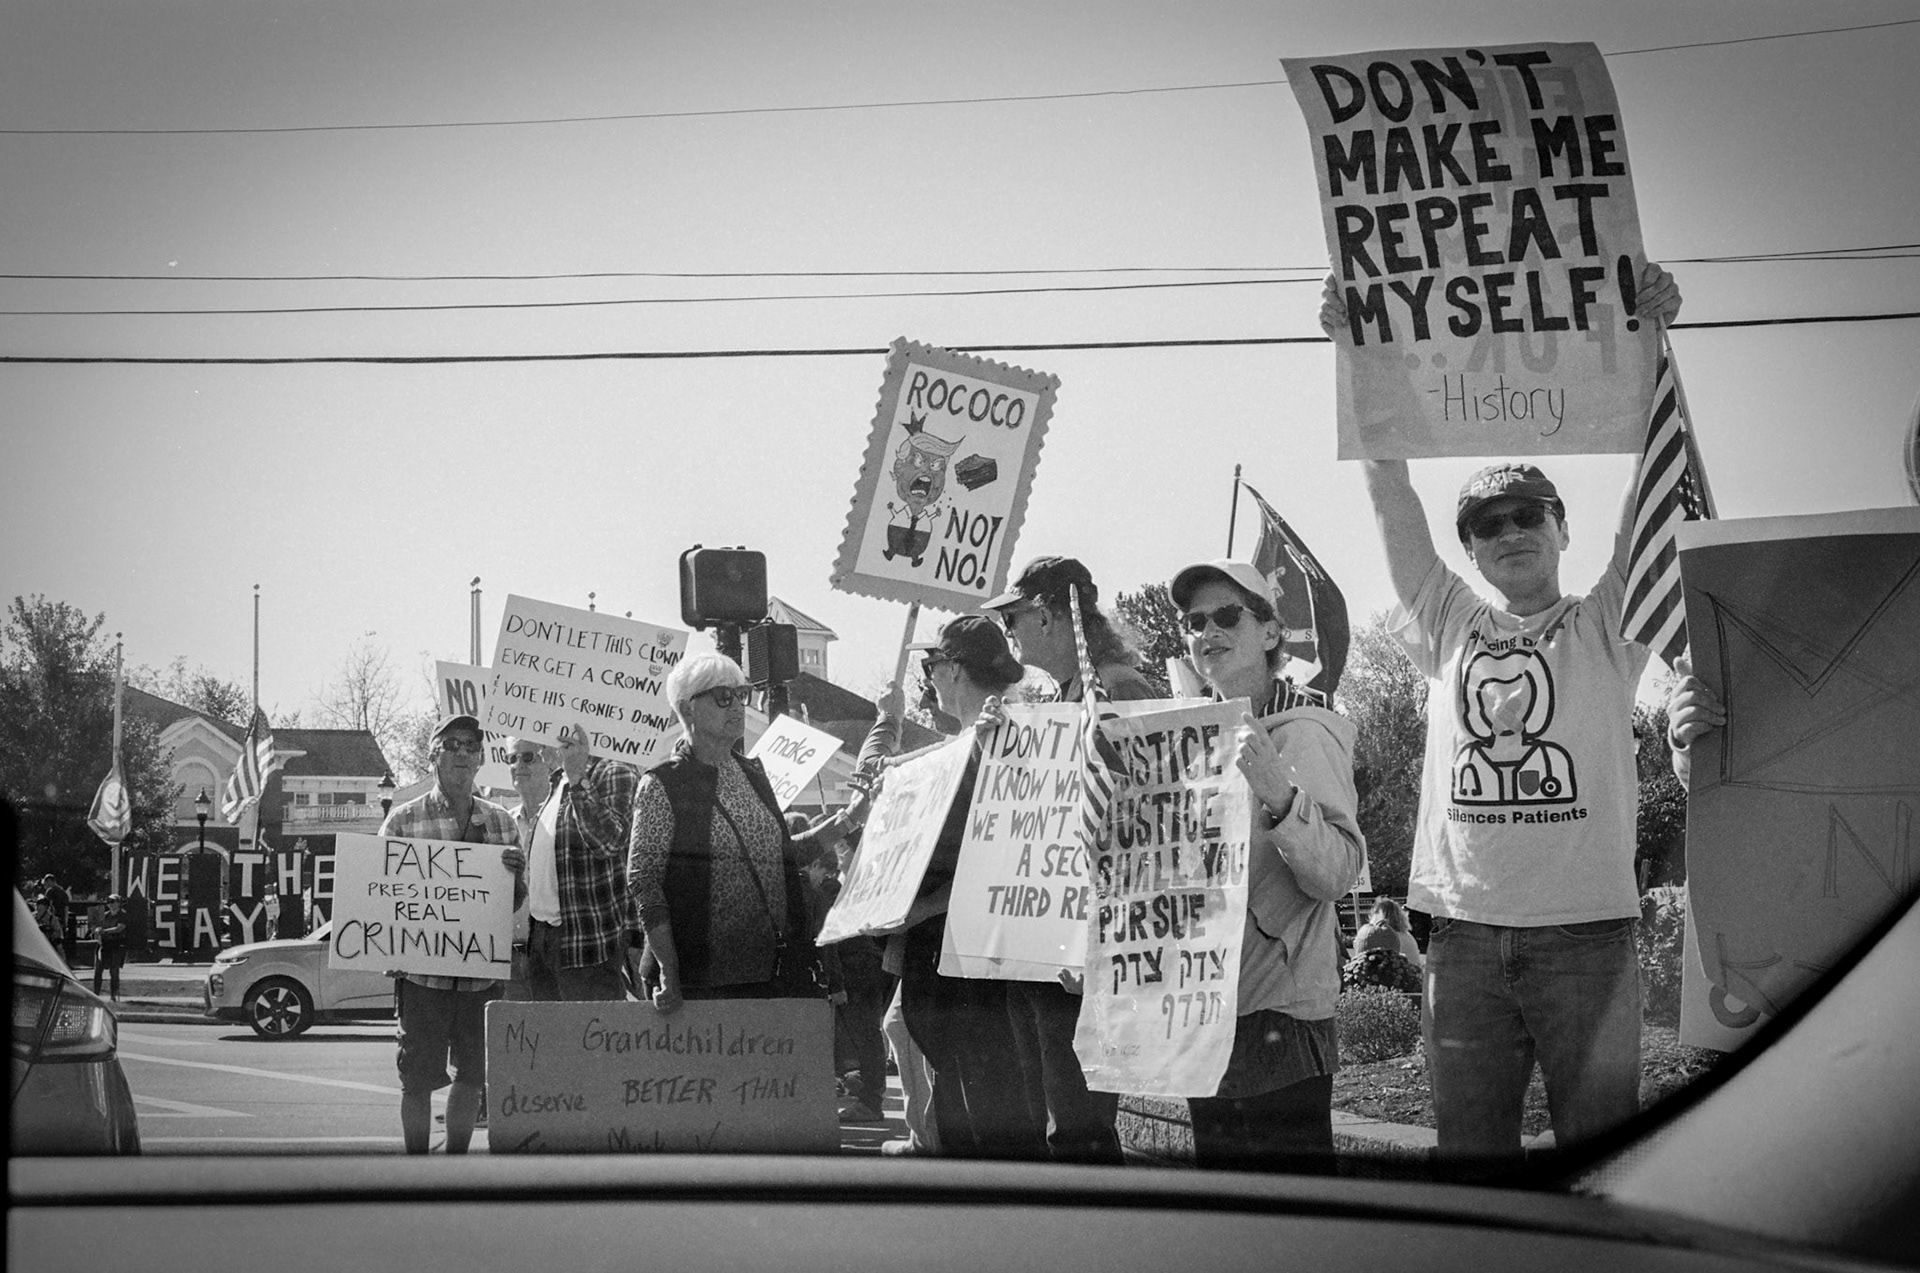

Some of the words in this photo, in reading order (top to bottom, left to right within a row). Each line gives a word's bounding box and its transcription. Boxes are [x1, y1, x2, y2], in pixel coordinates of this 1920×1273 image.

[1310, 49, 1551, 124] DON'T
[1322, 120, 1512, 197] MAKE
[1530, 114, 1625, 178] ME
[1334, 183, 1610, 281] REPEAT
[1345, 254, 1640, 346] MYSELF!
[906, 371, 1026, 430] ROCOCO
[506, 614, 566, 645] DON'T
[567, 627, 602, 650] LET
[606, 633, 632, 656] THIS
[638, 643, 684, 667] CLOWN
[502, 648, 541, 673] EVER
[544, 657, 577, 679] GET
[581, 667, 594, 682] A
[601, 669, 662, 696] CROWN
[445, 678, 479, 715] NO
[504, 681, 539, 703] VOTE
[543, 690, 566, 708] HIS
[571, 696, 625, 721] CRONIES
[631, 709, 669, 732] DOWN
[497, 711, 527, 731] OUT
[532, 720, 554, 735] OF
[1001, 717, 1071, 760] DON'T
[767, 735, 817, 765] make
[1112, 723, 1223, 792] USTICE
[976, 765, 992, 804] I
[990, 765, 1050, 801] KNOW
[971, 809, 999, 842] WE
[1009, 805, 1073, 841] WON'T
[1095, 787, 1222, 852] JUSTICE
[1447, 807, 1507, 824] Silences
[1512, 806, 1588, 824] Patients
[126, 856, 180, 901] WE
[233, 852, 335, 899] THE
[384, 839, 483, 880] FAKE
[1016, 843, 1032, 878] A
[1096, 846, 1189, 899] SHALL
[1201, 841, 1245, 889] YOU
[368, 881, 490, 904] PRESIDENT
[395, 901, 461, 922] REAL
[987, 884, 1052, 918] THIRD
[1059, 885, 1090, 921] RE
[155, 902, 265, 949] SAY
[336, 919, 511, 964] CRIMINAL
[1099, 893, 1206, 944] PURSUE
[1111, 946, 1164, 995] צדק
[1179, 947, 1227, 989] צדק
[506, 1019, 540, 1070] My
[582, 1017, 795, 1057] Grandchildren
[501, 1085, 588, 1118] deserve
[621, 1074, 718, 1106] BETTER
[735, 1073, 799, 1105] THAN
